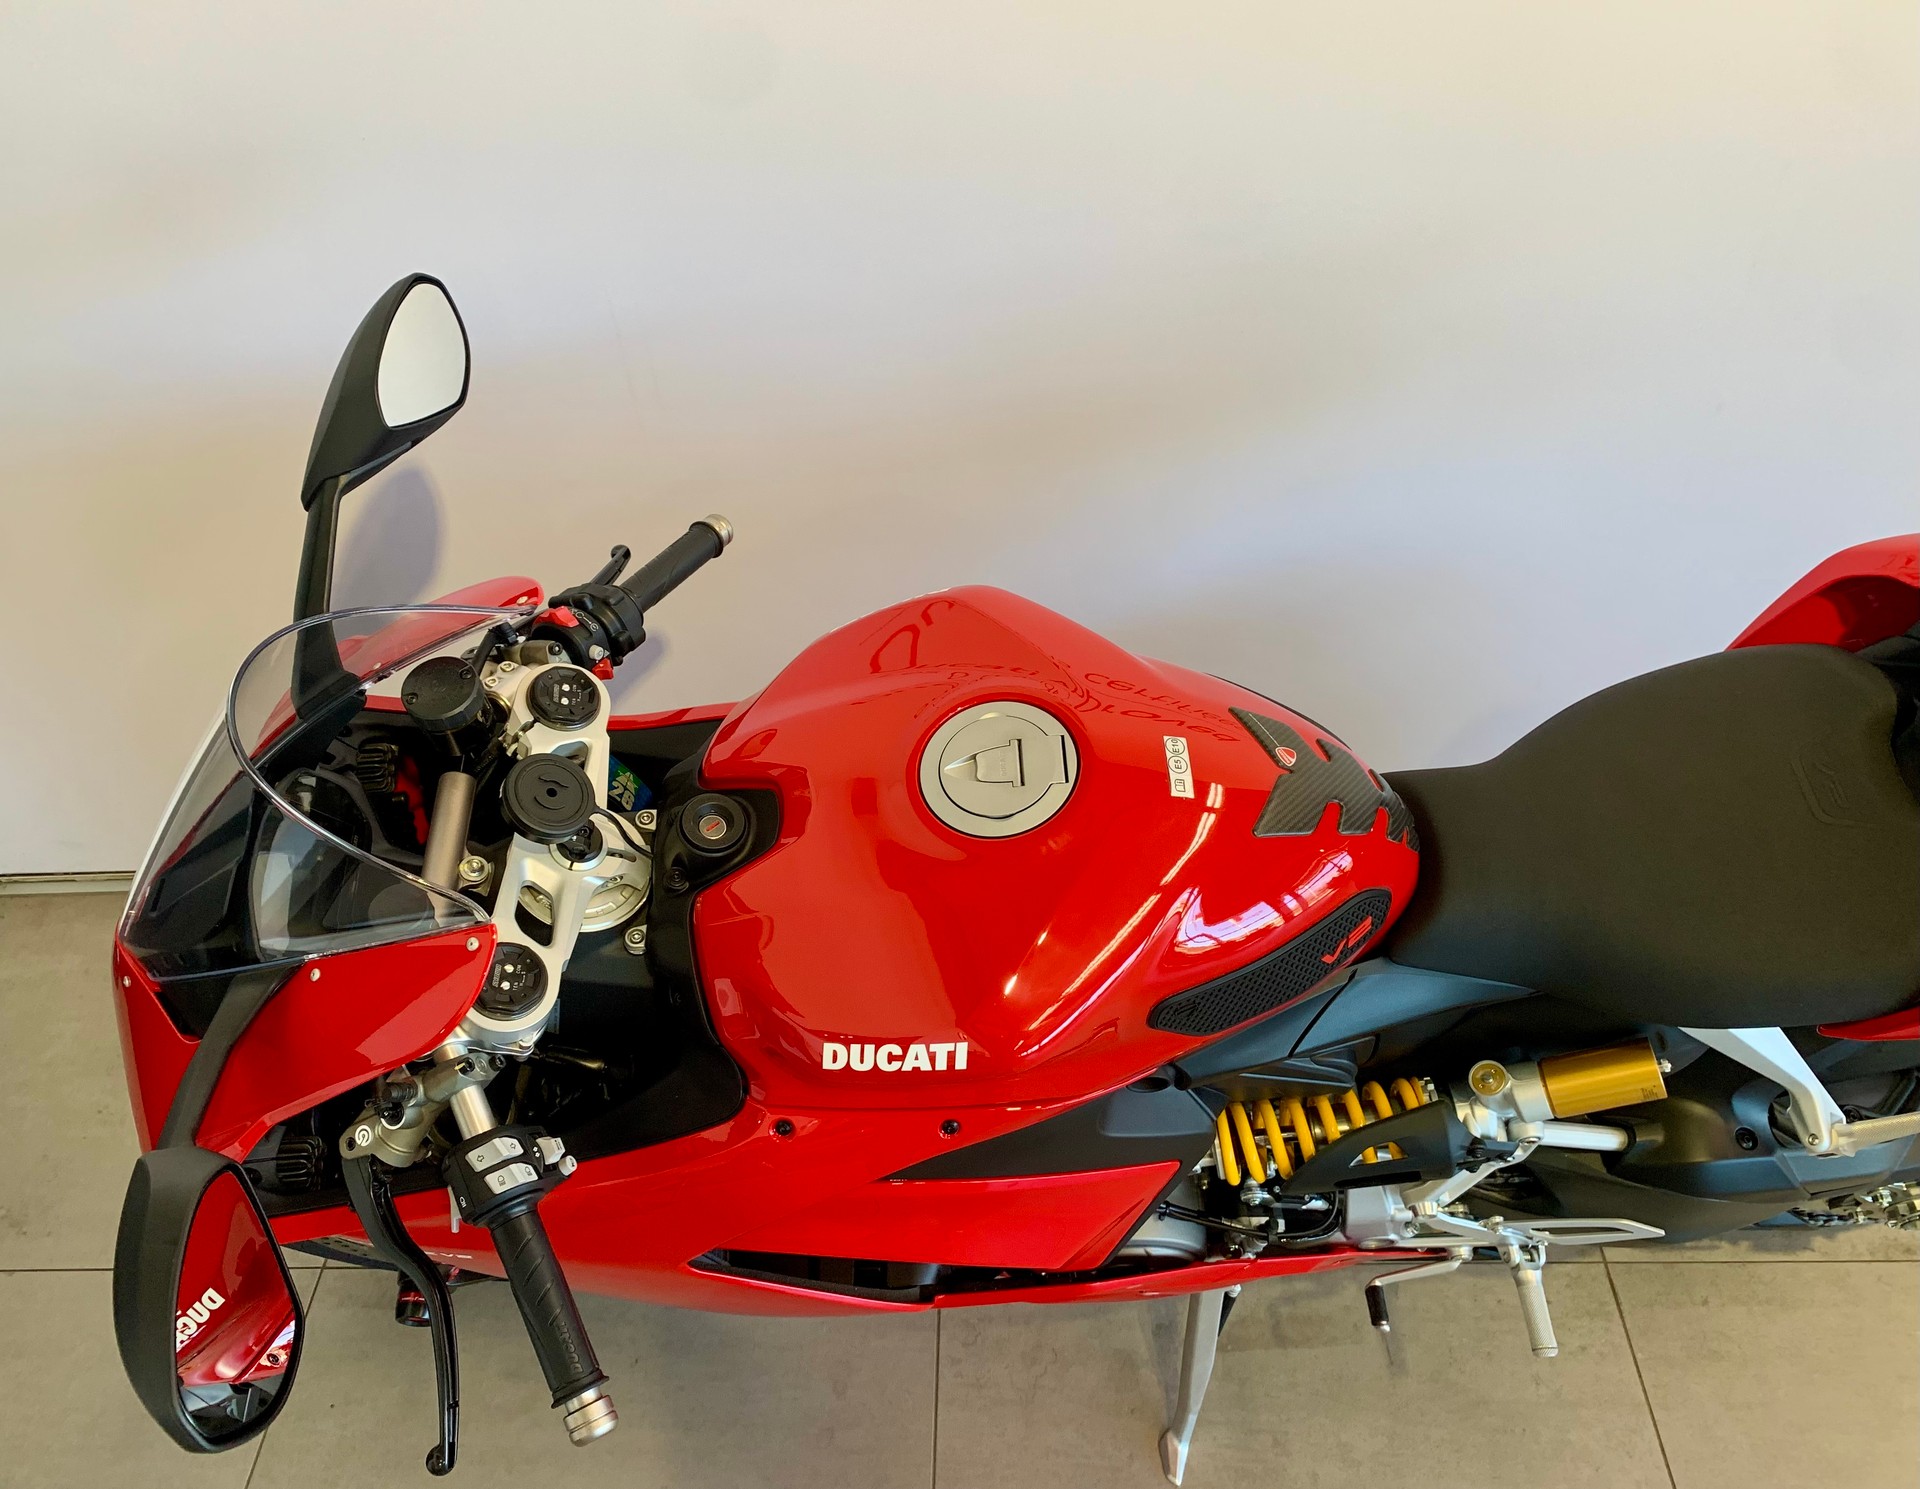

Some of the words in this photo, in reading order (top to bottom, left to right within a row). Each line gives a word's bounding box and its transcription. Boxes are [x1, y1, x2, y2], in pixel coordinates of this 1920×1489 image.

[1171, 738, 1180, 754] E10
[1174, 759, 1182, 770] E5
[822, 1042, 968, 1071] DUCATI
